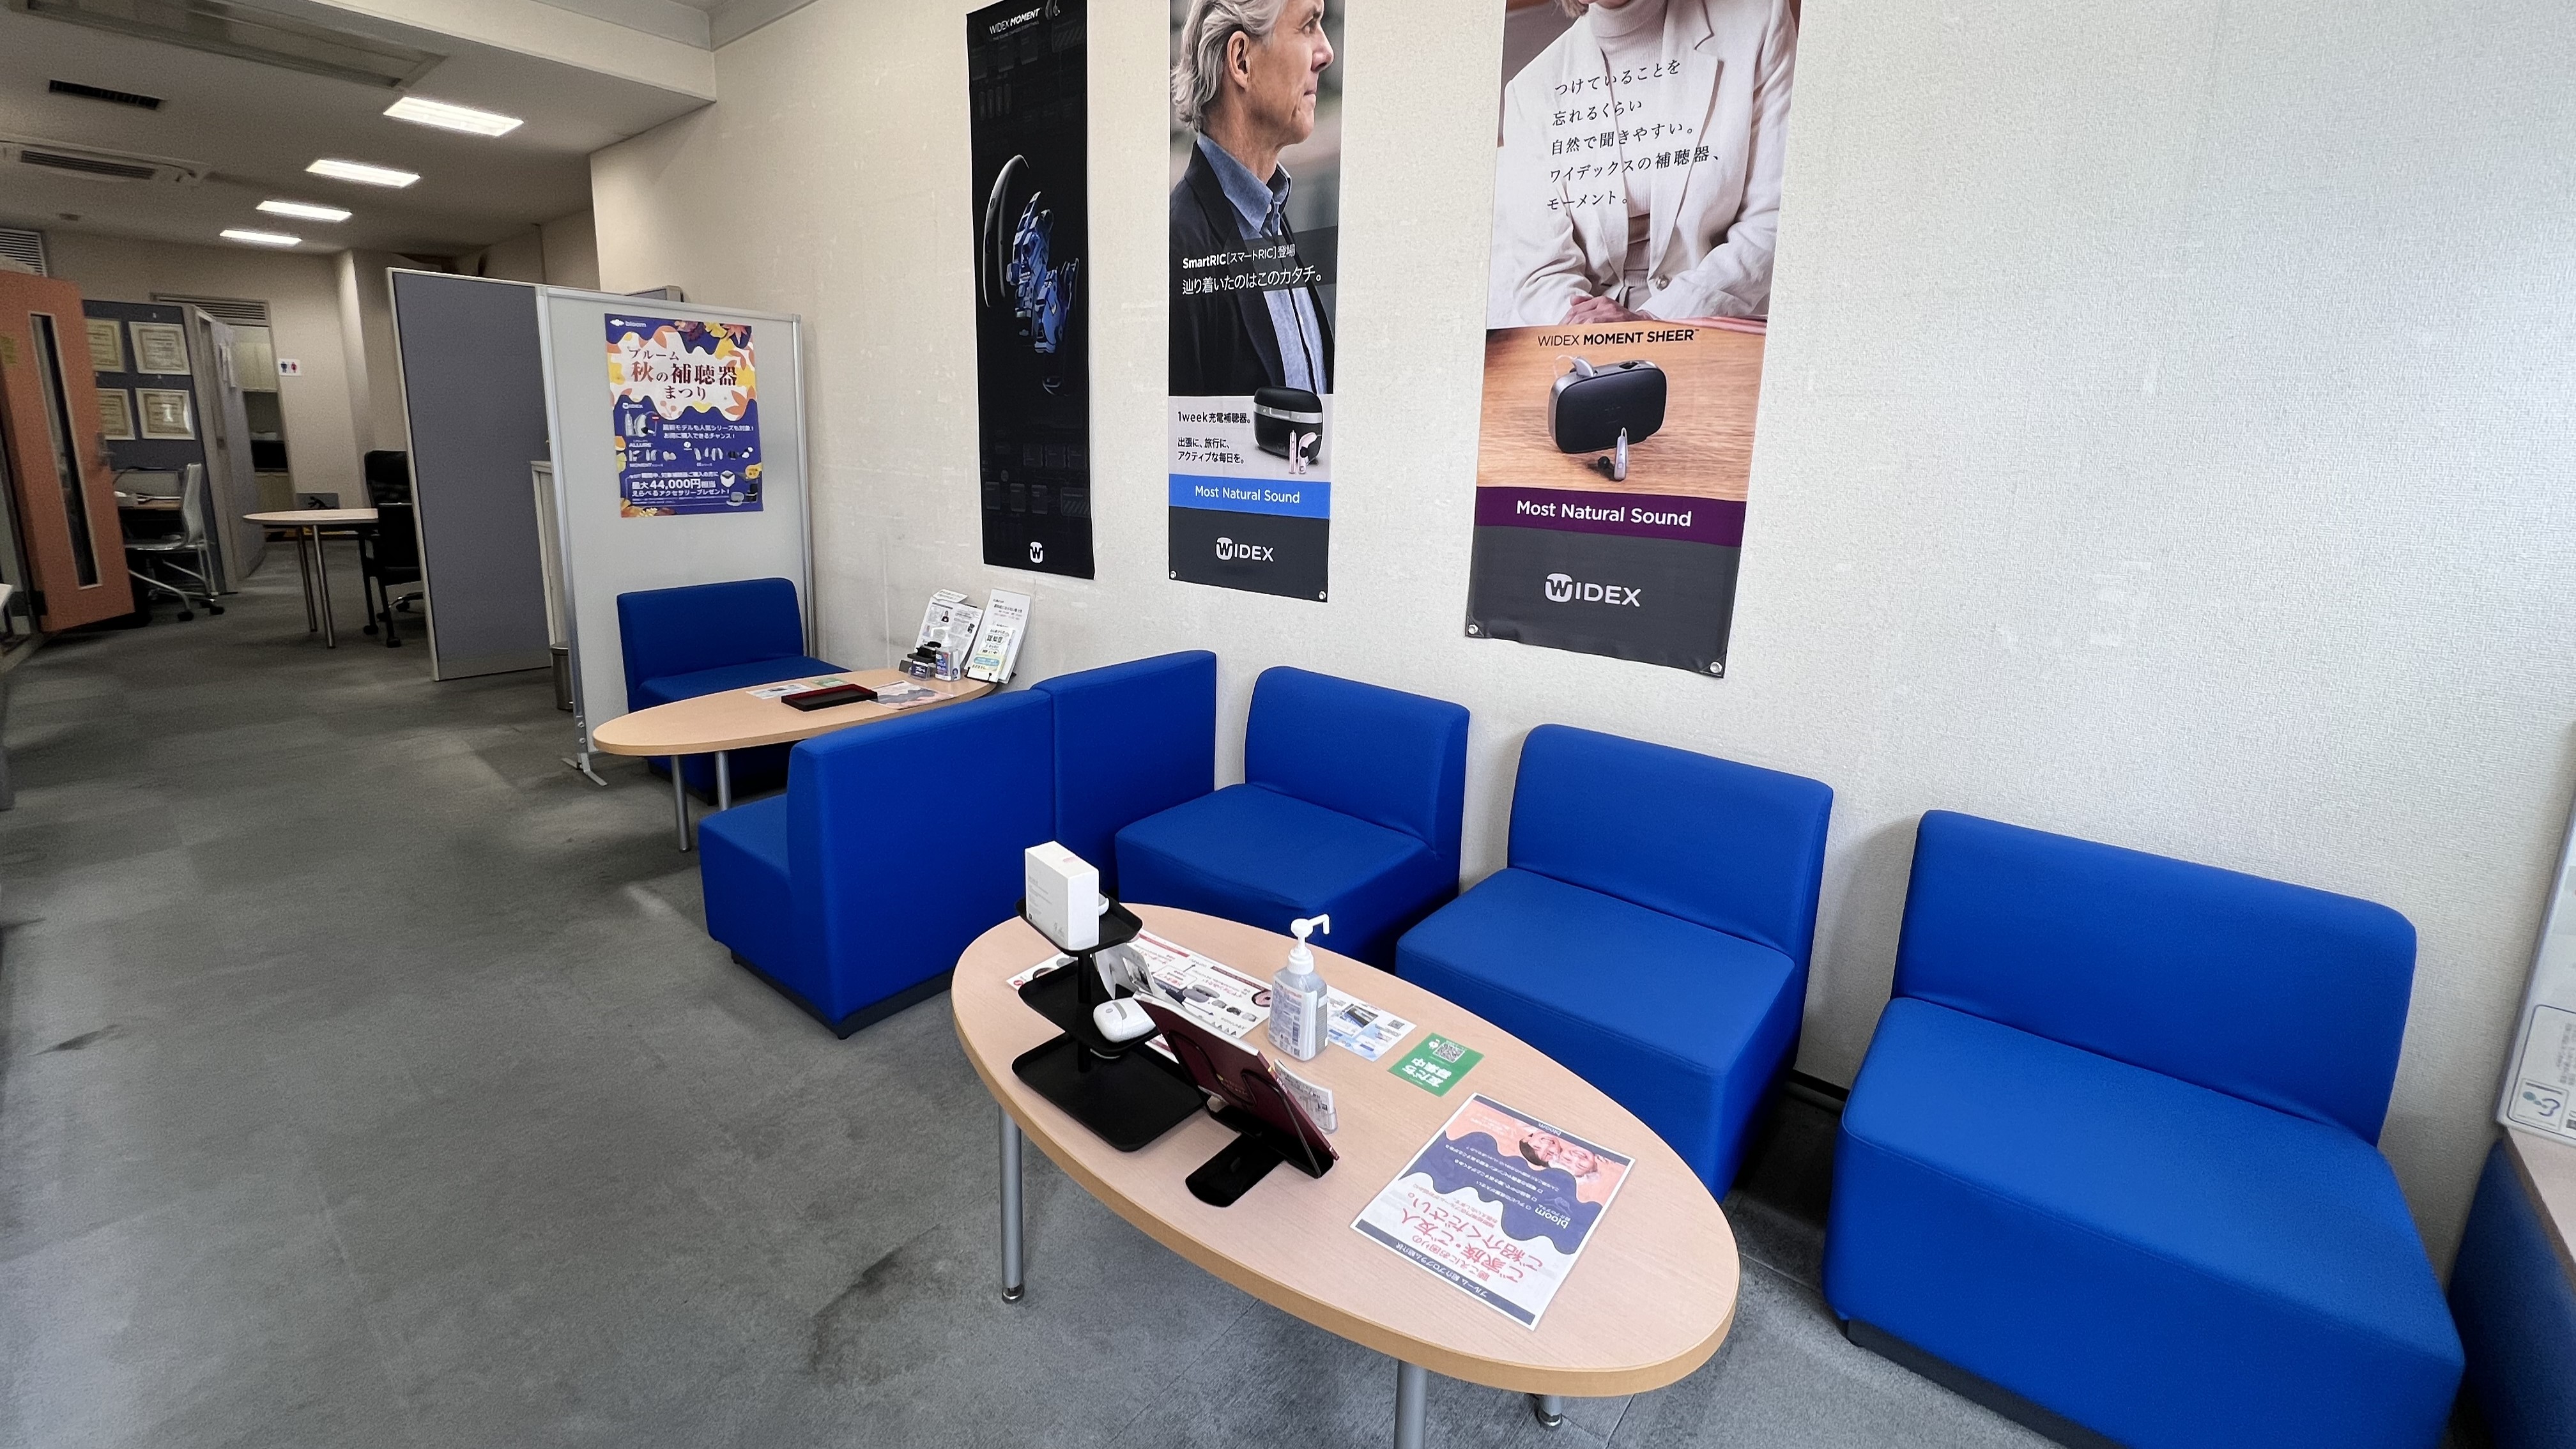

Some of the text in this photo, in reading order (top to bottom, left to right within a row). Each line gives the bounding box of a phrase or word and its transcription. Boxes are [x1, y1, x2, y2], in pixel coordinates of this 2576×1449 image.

[989, 19, 1010, 34] WIDEX
[1010, 8, 1041, 27] MOMENT
[1554, 59, 1680, 96] つけていることを
[1552, 100, 1642, 126] 忘れるくらい
[1551, 123, 1692, 156] 自然で聞きやすい。
[1551, 146, 1719, 183] ワイデックスの補聴器、
[1547, 190, 1627, 210] モーメント。
[1182, 264, 1322, 295] 辿り着いたのはこのカタチ。
[1538, 335, 1579, 347] WIDEX
[1583, 332, 1643, 346] MOMENT
[628, 349, 679, 361] ブルーム
[631, 361, 737, 386] 秋の補聴器
[664, 386, 706, 401] まつり
[1177, 437, 1230, 449] 出張に、旅行に、
[1177, 451, 1245, 464] アクティブな毎日を。
[1195, 486, 1300, 504] Most Natural Sound
[1517, 501, 1692, 527] Most Natural Sound
[1216, 537, 1274, 562] WIDEX
[1545, 573, 1641, 607] WIDEX
[1538, 1123, 1561, 1136] bloom
[1535, 1208, 1569, 1229] bloom
[1407, 1192, 1543, 1272] ご紹介ください。
[1402, 1208, 1523, 1283] ご家族・ご友人
[1462, 1279, 1488, 1298] ブルーム
